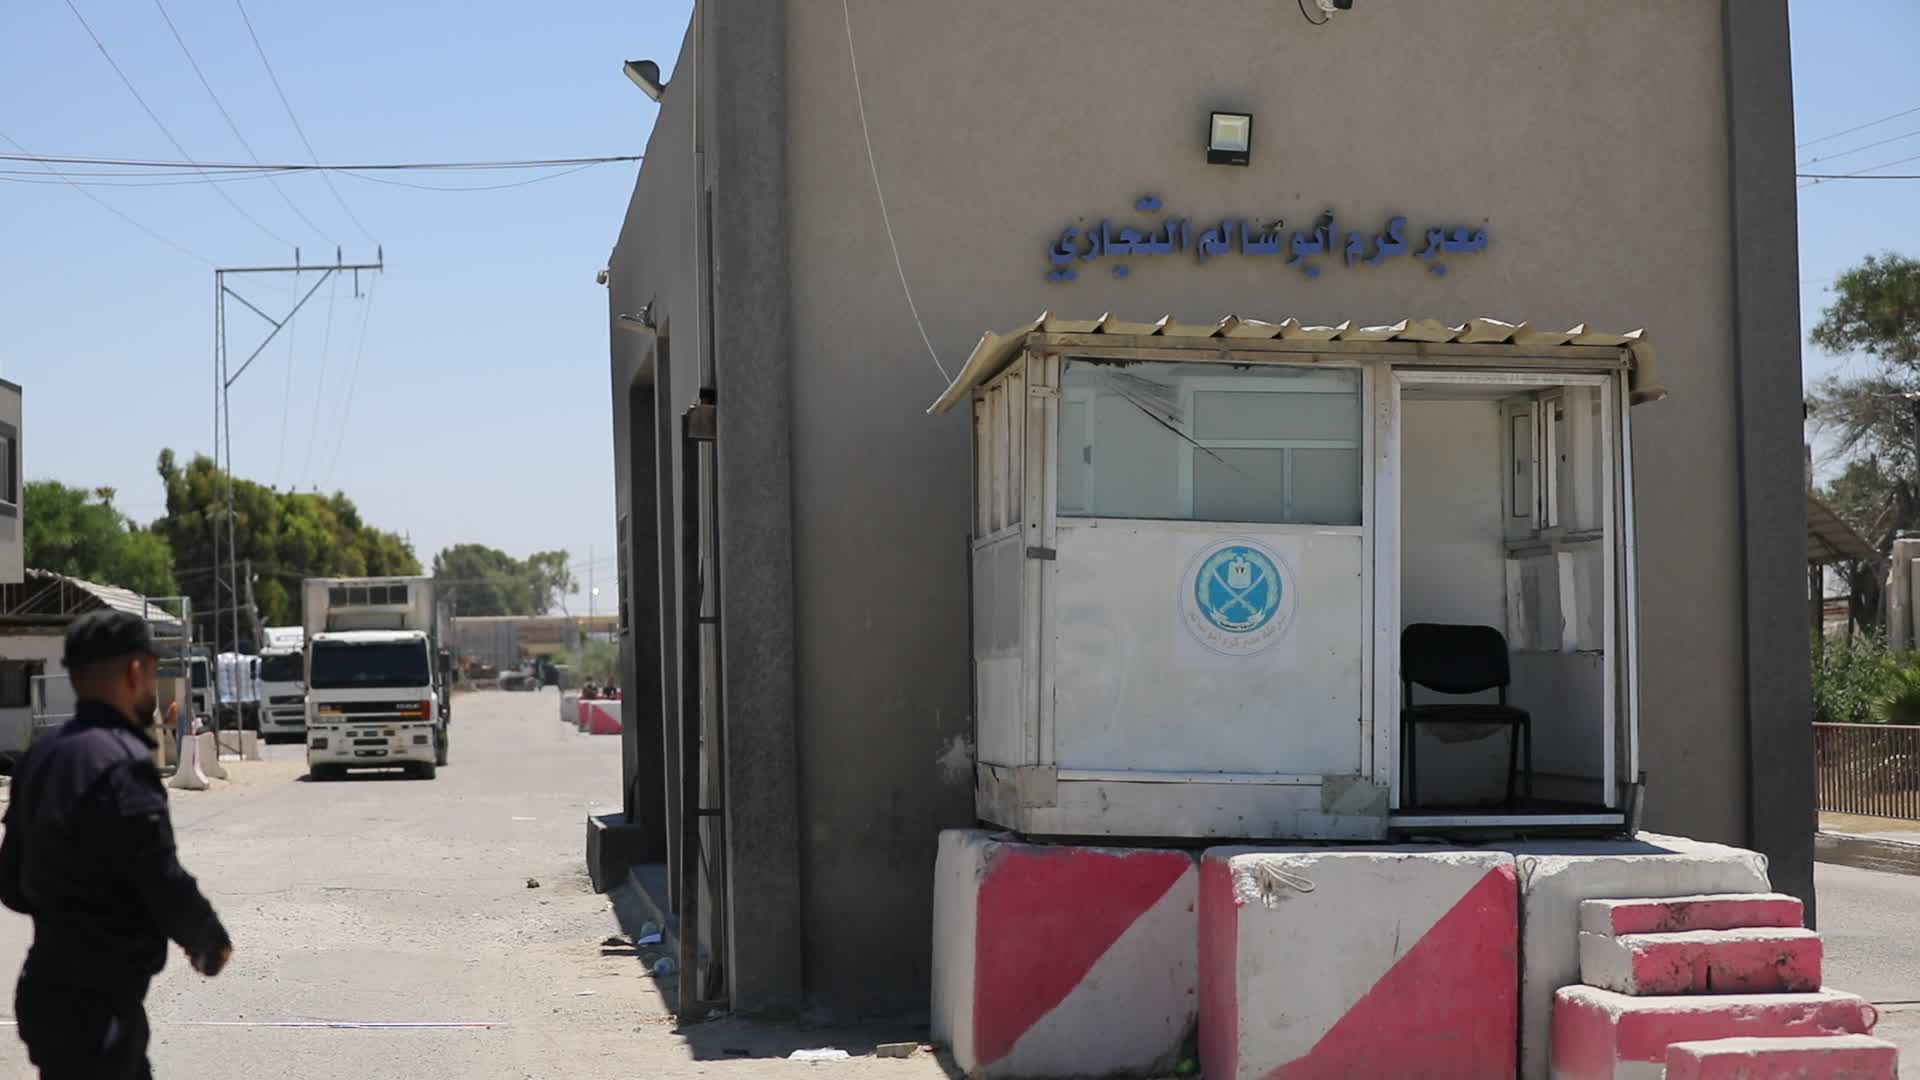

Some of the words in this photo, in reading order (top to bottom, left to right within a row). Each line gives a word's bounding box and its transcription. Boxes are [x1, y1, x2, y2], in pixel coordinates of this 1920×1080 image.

[1045, 195, 1190, 282] التجاري
[1196, 218, 1281, 267] سالم
[1345, 215, 1408, 267] كرم
[1414, 222, 1489, 277] معبر
